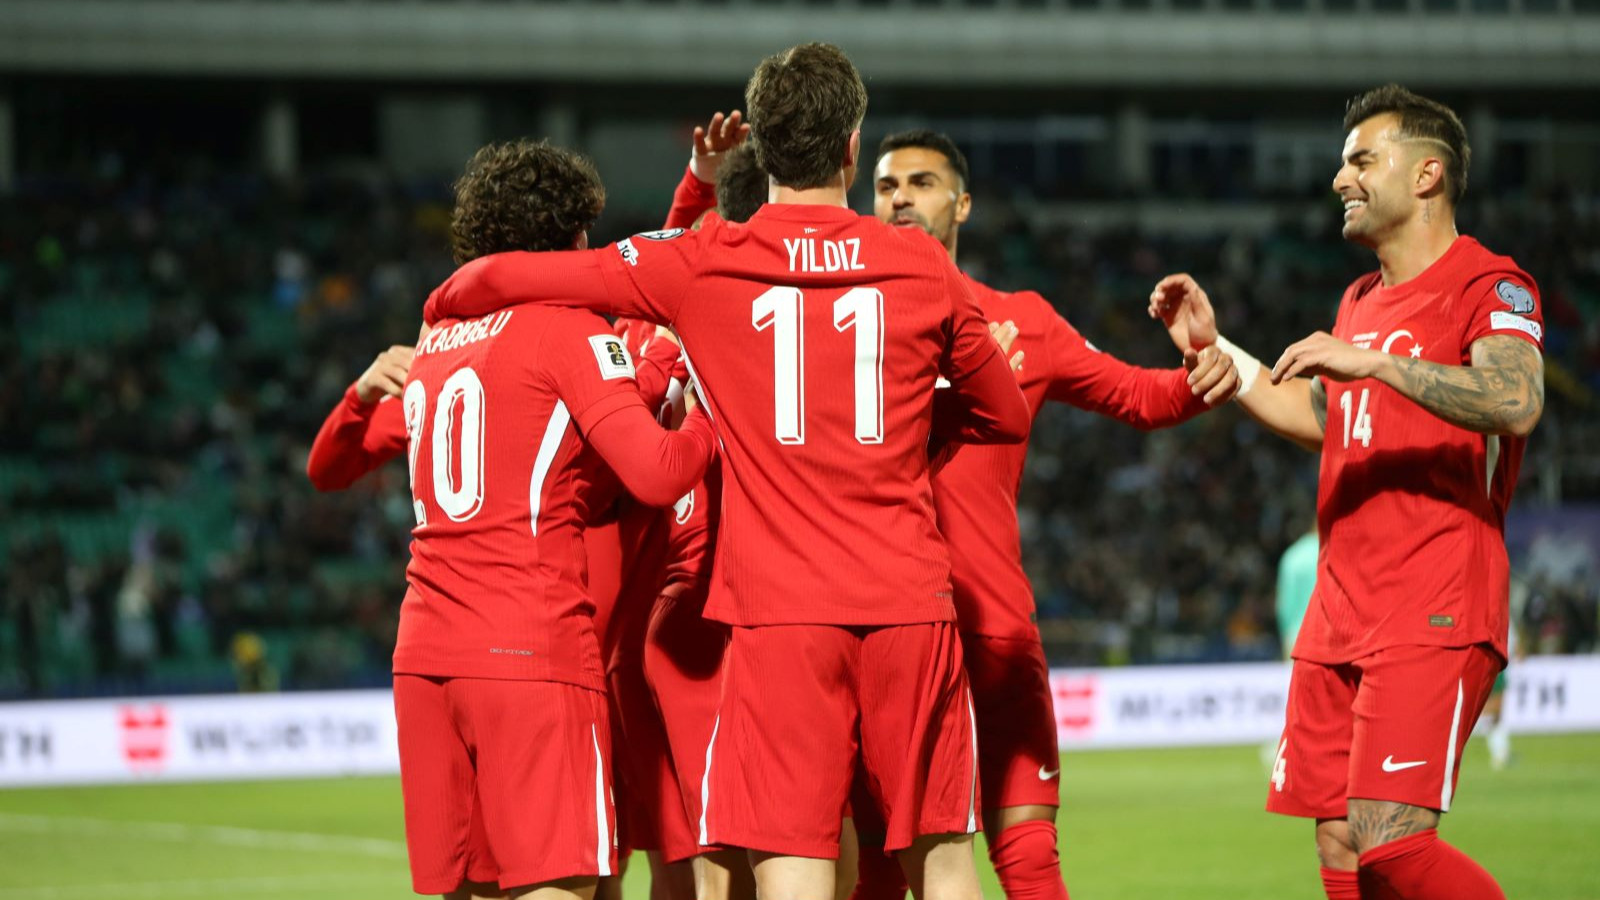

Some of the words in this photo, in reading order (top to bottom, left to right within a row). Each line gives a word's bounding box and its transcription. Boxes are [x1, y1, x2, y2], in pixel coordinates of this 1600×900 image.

[783, 237, 865, 273] YILDIZ
[752, 286, 884, 445] 11
[1340, 388, 1373, 449] 14
